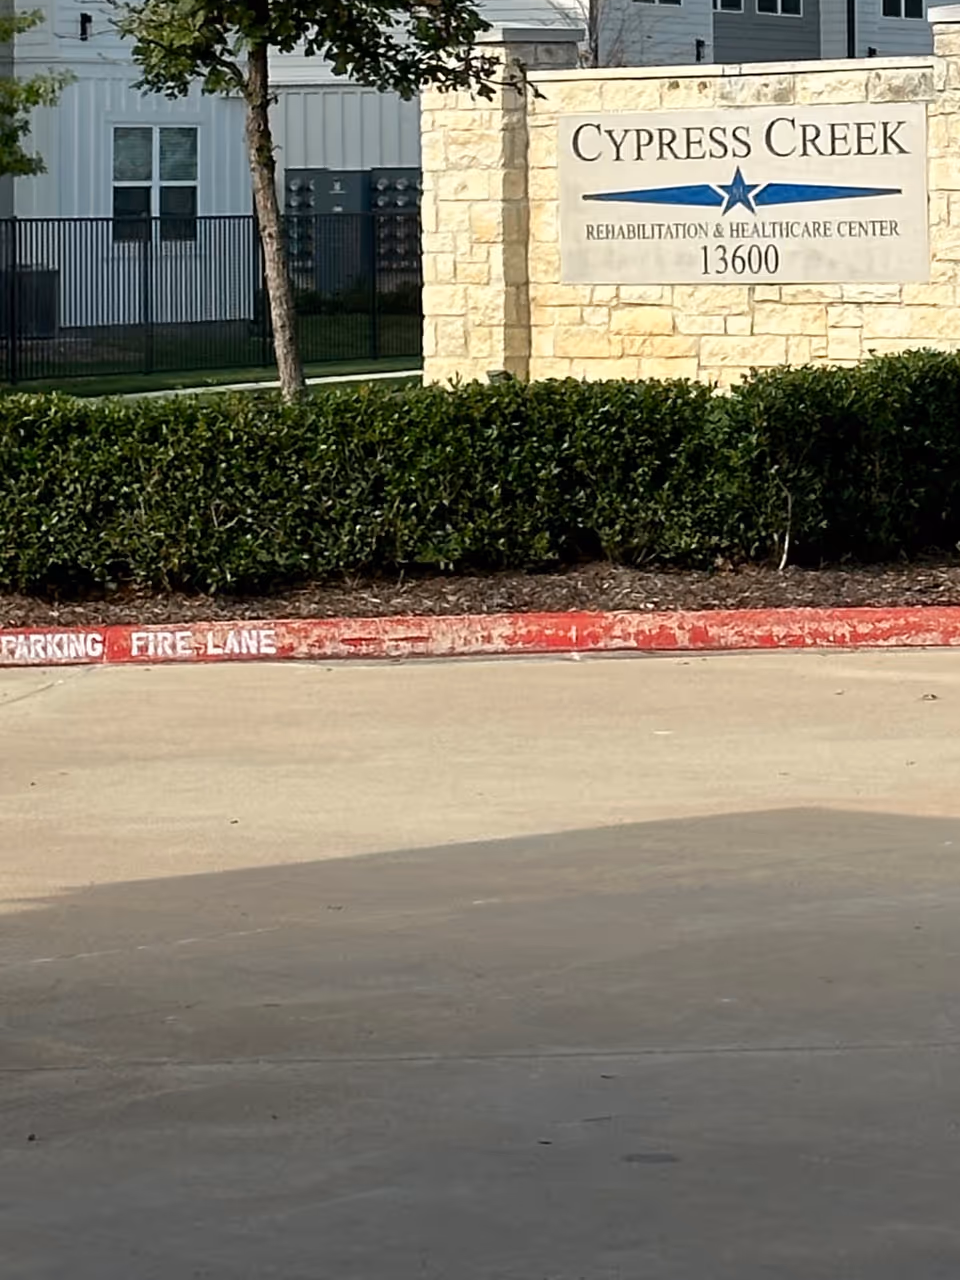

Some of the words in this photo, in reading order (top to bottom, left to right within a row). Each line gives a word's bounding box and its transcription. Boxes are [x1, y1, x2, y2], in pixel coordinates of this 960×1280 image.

[571, 122, 751, 162] CYPRESS
[764, 117, 911, 158] CREEK
[585, 222, 708, 240] REHABILITATION
[712, 225, 725, 239] &
[729, 221, 832, 239] HEALTHCARE
[837, 220, 900, 237] CENTER
[701, 244, 779, 274] 13600
[0, 632, 103, 659] PARKING
[131, 631, 193, 657] FIRE
[207, 629, 277, 655] LANE
